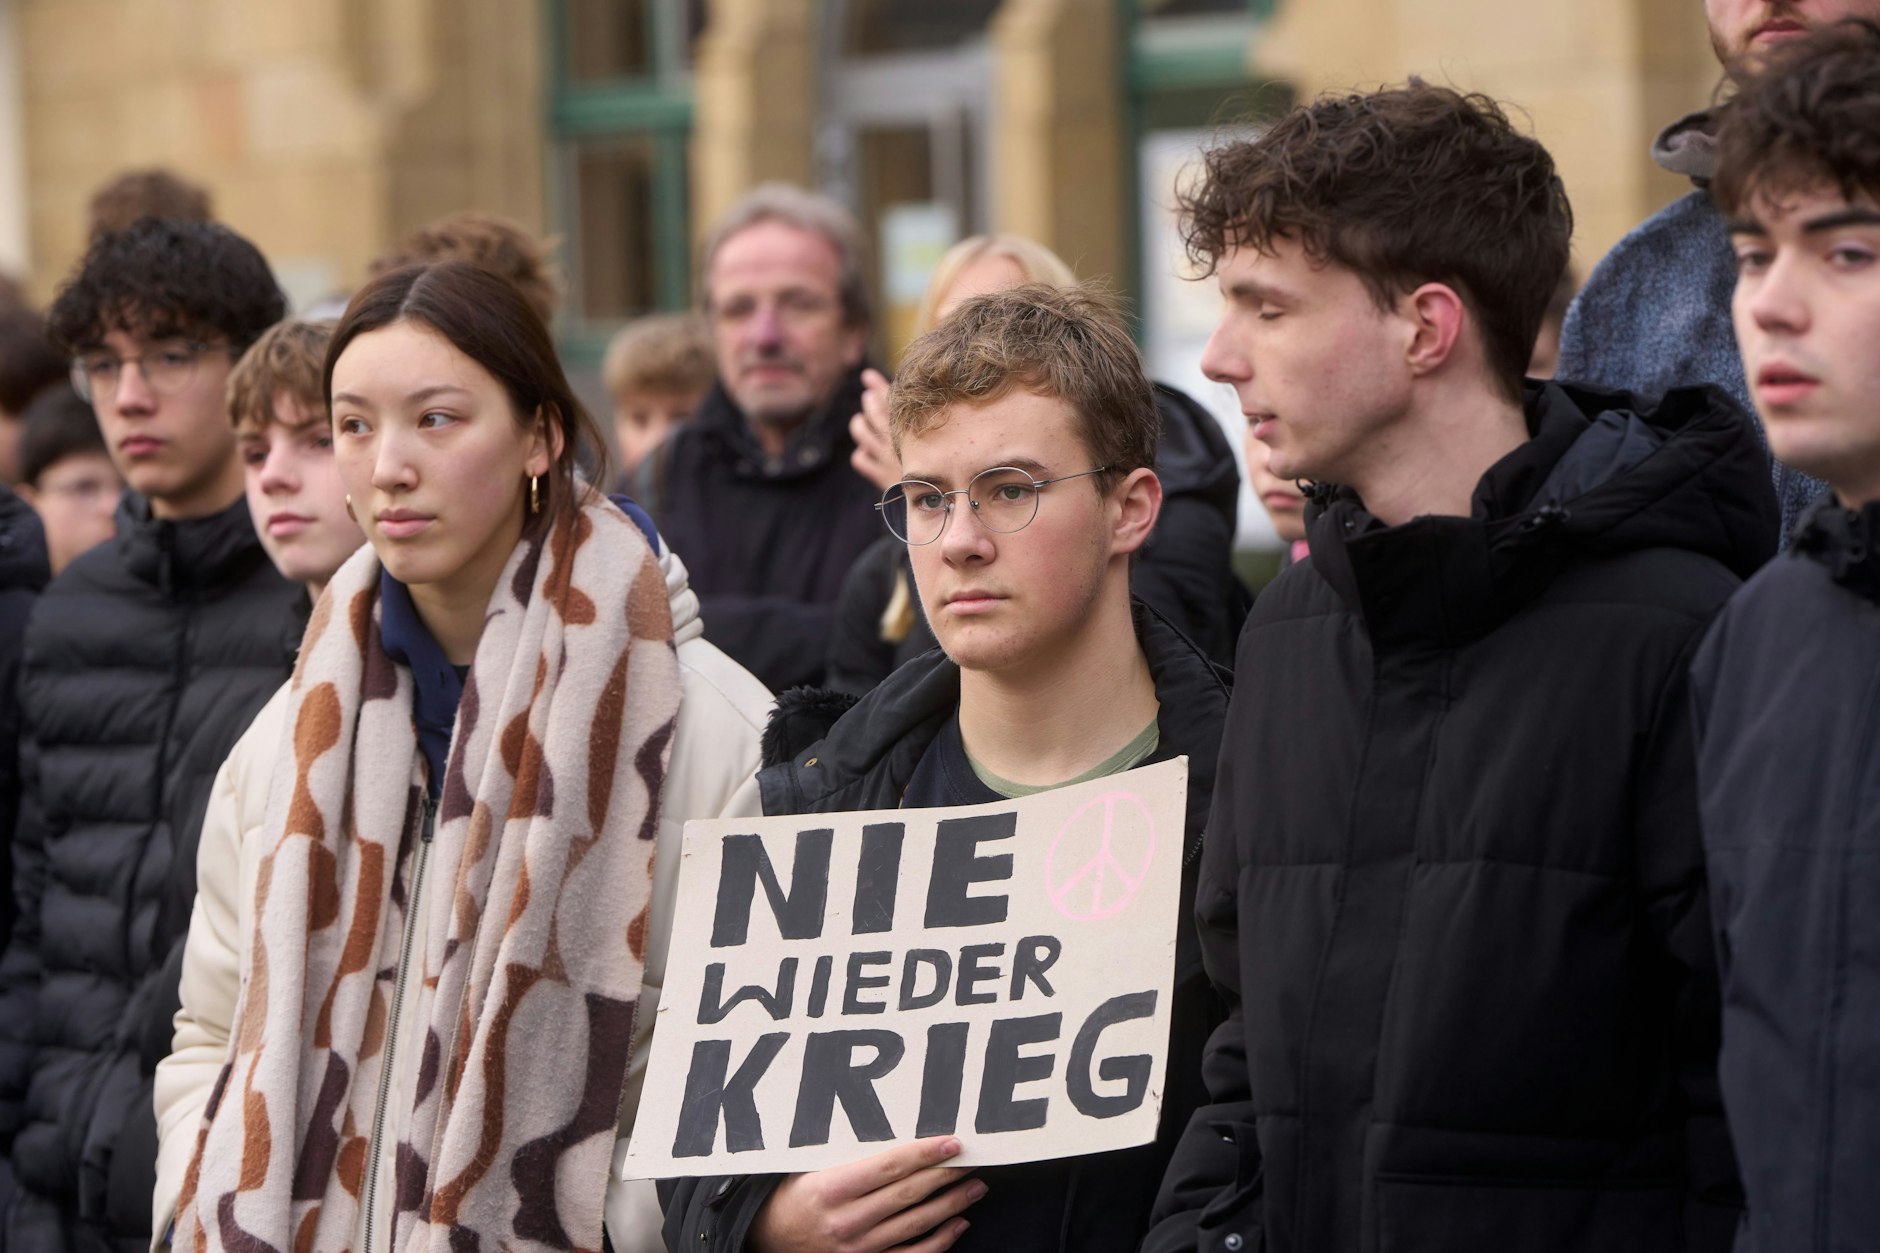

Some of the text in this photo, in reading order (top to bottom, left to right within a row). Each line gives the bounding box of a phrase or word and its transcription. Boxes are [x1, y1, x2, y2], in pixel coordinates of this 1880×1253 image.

[710, 811, 1018, 948] NIE
[696, 935, 1062, 1025] WIEDER
[671, 989, 1159, 1159] KRIEG
